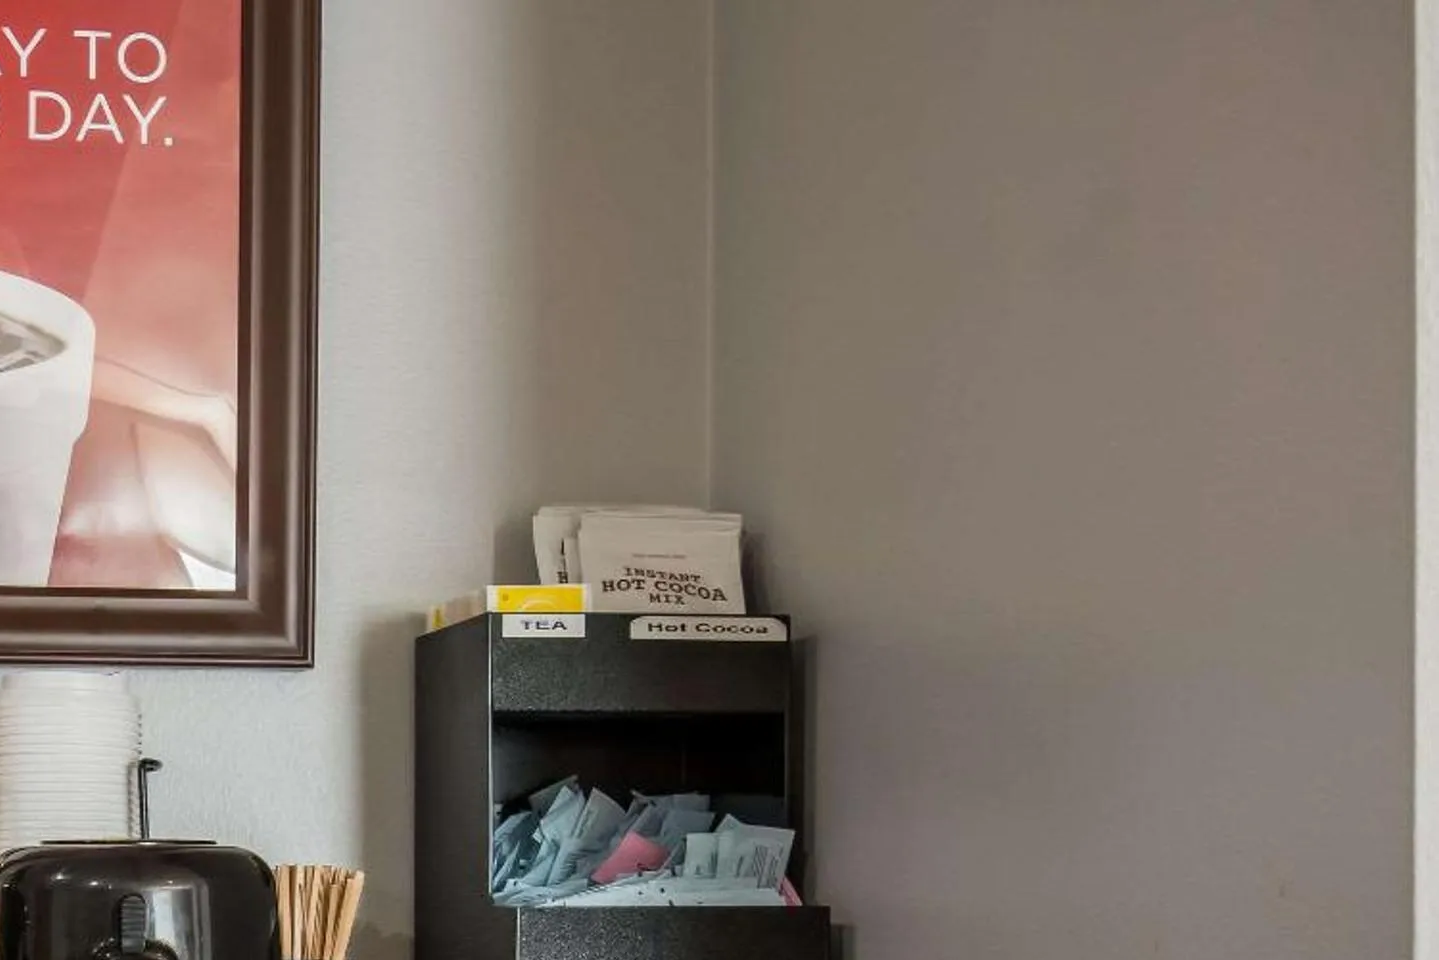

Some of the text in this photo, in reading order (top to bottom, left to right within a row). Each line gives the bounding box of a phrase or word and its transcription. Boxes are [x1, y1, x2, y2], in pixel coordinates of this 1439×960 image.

[73, 30, 167, 84] TO
[27, 90, 174, 147] DAY.
[624, 567, 701, 583] INSTANT
[601, 579, 728, 602] HOT COCOA
[649, 593, 686, 605] MIX
[520, 620, 568, 631] TEA
[648, 622, 769, 634] Hot Cocoa
